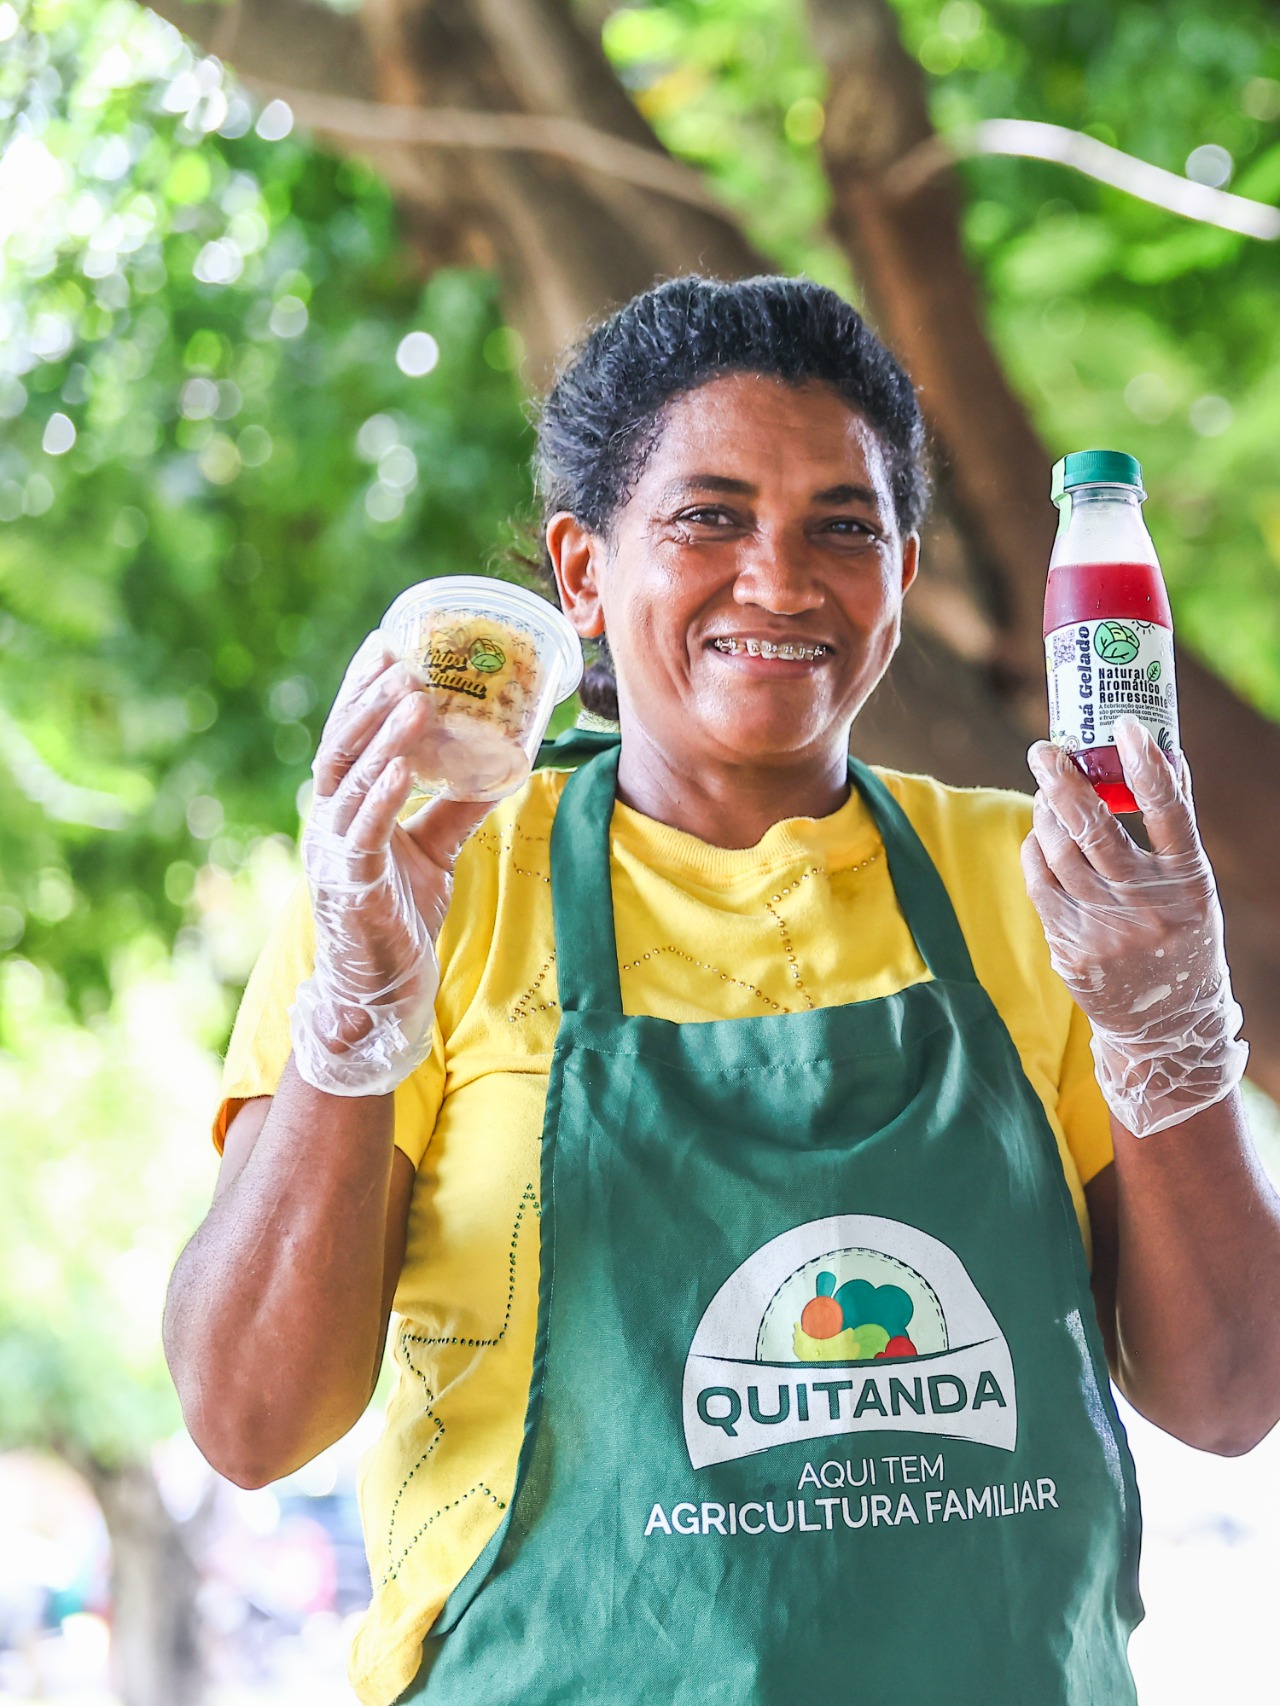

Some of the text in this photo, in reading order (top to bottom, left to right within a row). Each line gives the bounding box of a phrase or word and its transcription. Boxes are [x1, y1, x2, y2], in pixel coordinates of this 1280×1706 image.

[1075, 626, 1095, 744] Chá Gelado
[1098, 667, 1144, 680] Natural
[1099, 679, 1160, 695] Aromático
[1099, 691, 1168, 708] Refrescante
[696, 1369, 1007, 1437] QUITANDA
[797, 1453, 944, 1491] AQUI TEM
[643, 1476, 1060, 1537] AGRICULTURA FAMILIAR
